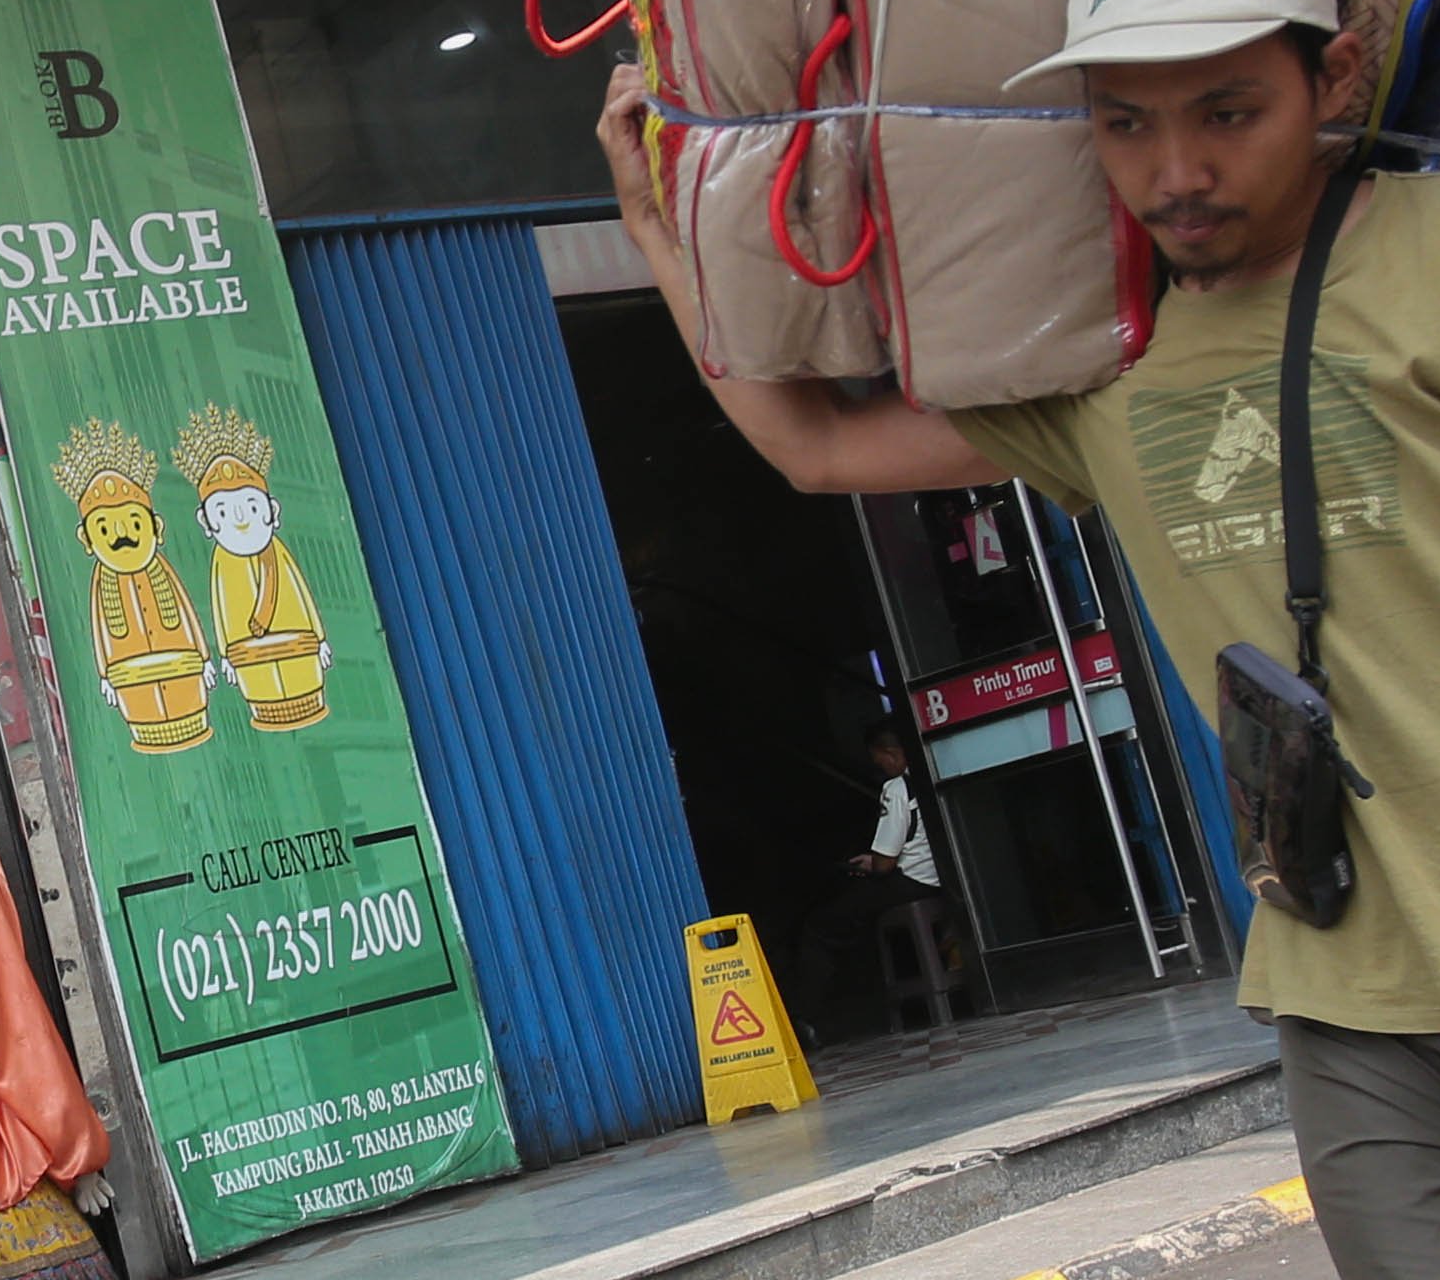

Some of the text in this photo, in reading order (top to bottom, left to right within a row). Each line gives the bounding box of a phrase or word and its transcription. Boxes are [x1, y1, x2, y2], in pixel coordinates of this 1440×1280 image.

[35, 61, 67, 129] BLOK
[38, 49, 120, 140] B
[0, 276, 248, 337] AVAILABLE
[973, 657, 1056, 696] Pintu Timur
[201, 827, 351, 894] CALL CENTER
[157, 887, 423, 1022] (021) 2357 2000
[701, 968, 752, 987] WET FLOOR
[704, 957, 744, 974] CAUTION
[176, 1059, 486, 1173] JL. FACHRUDIN NO. 78, 80, 82 LANTAI 6
[211, 1154, 302, 1198] KAMPUNG
[302, 1140, 344, 1174] BALI
[351, 1123, 414, 1160] TANAH
[416, 1105, 474, 1143] ABANG
[294, 1164, 415, 1221] JAKARTA 10250
